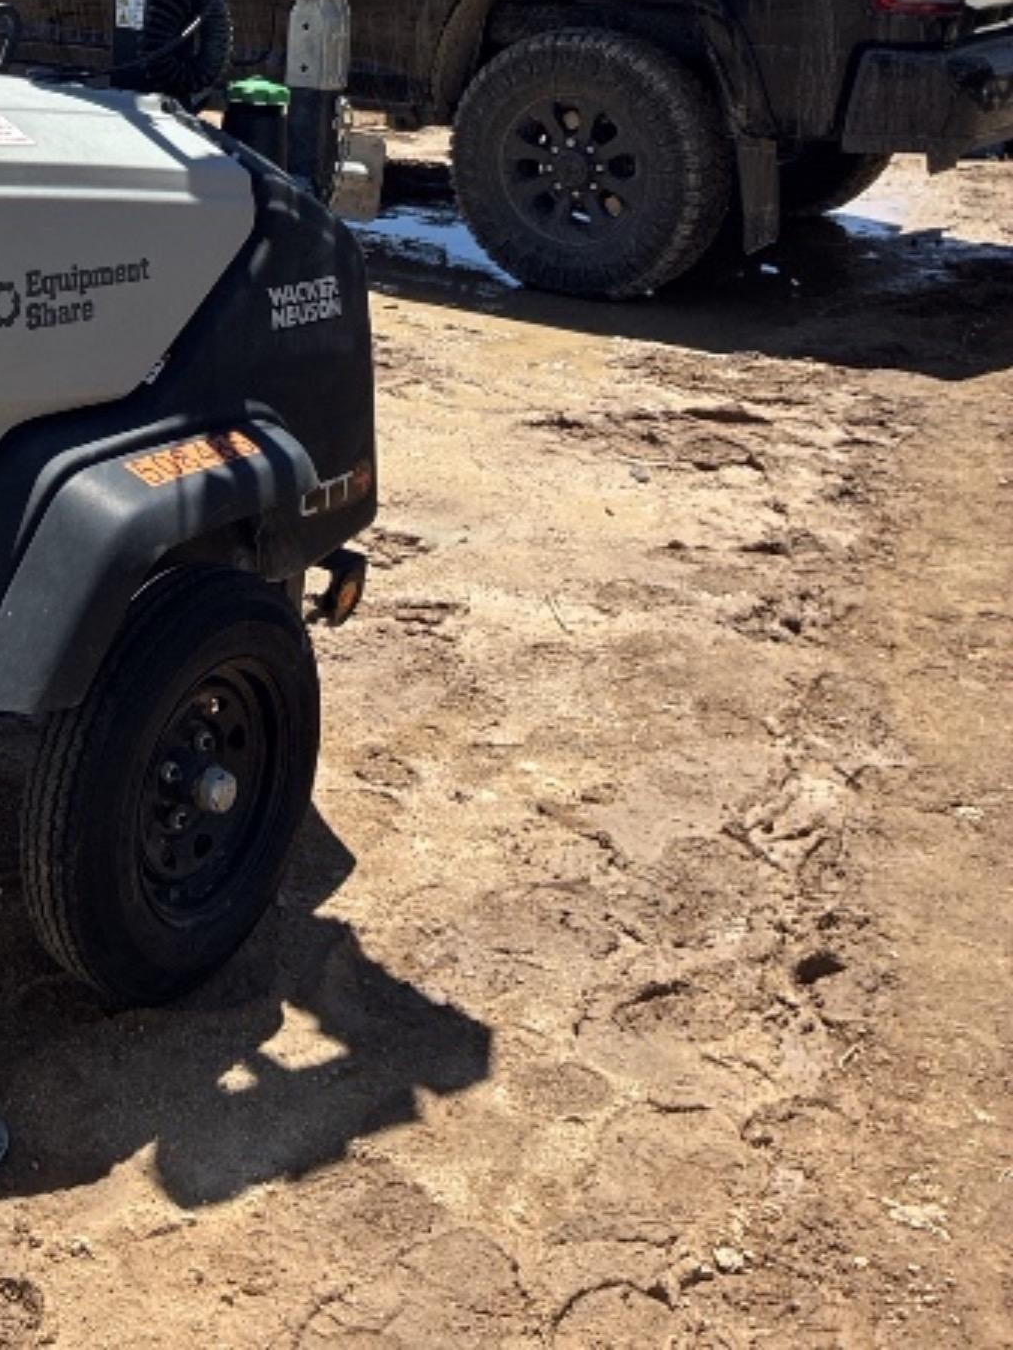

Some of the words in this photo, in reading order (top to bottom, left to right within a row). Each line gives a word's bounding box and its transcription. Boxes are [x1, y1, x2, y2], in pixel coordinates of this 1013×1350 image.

[25, 257, 150, 300] Equipment
[267, 275, 339, 306] WACKER
[25, 300, 94, 330] Share
[271, 298, 342, 330] NEUSON
